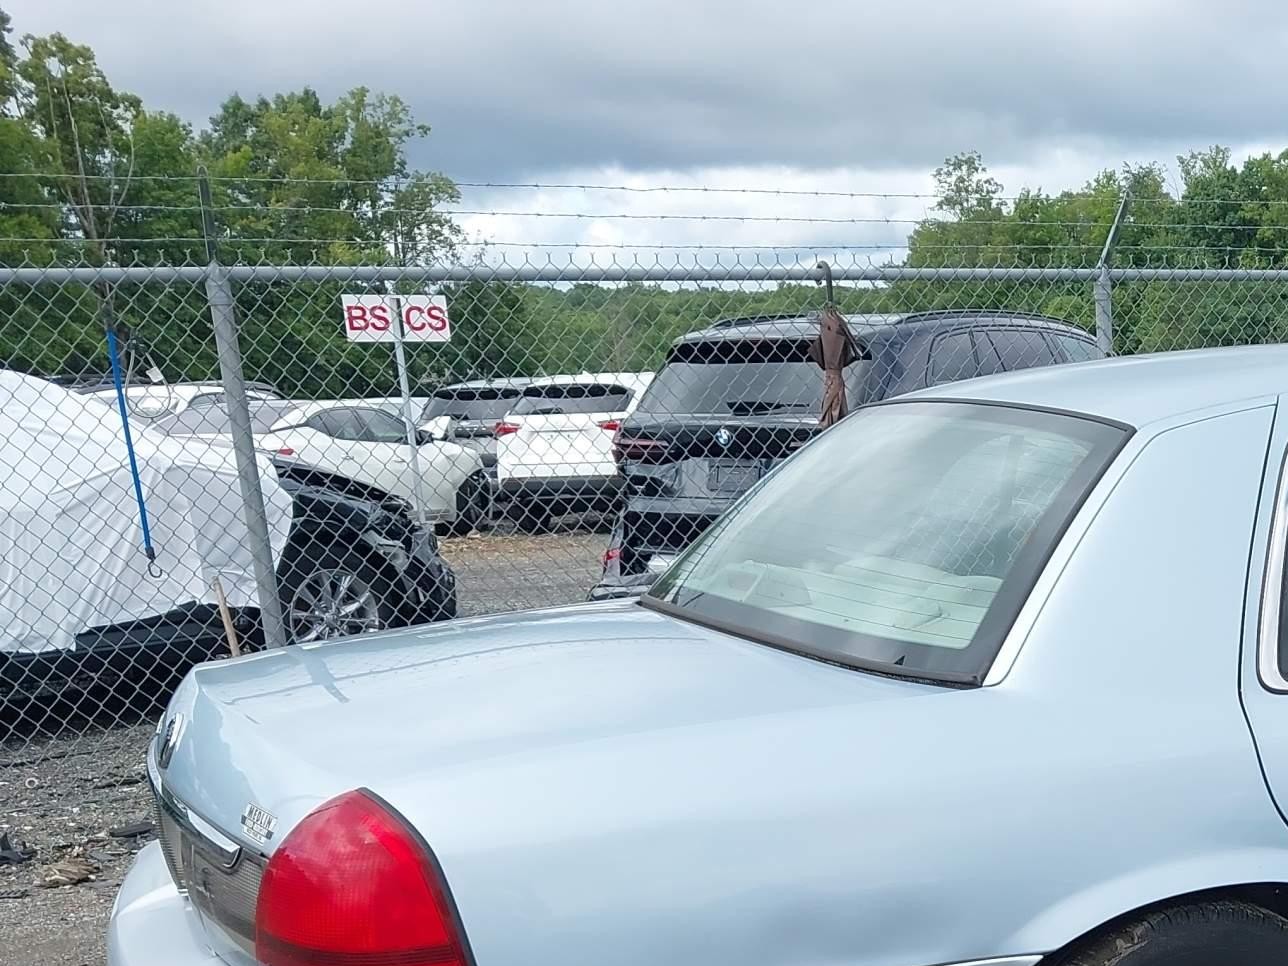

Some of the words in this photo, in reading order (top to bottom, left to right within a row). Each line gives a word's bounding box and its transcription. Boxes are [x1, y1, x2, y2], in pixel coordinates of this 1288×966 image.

[346, 305, 390, 331] BS
[405, 305, 447, 331] CS
[247, 805, 273, 830] MEDLIN
